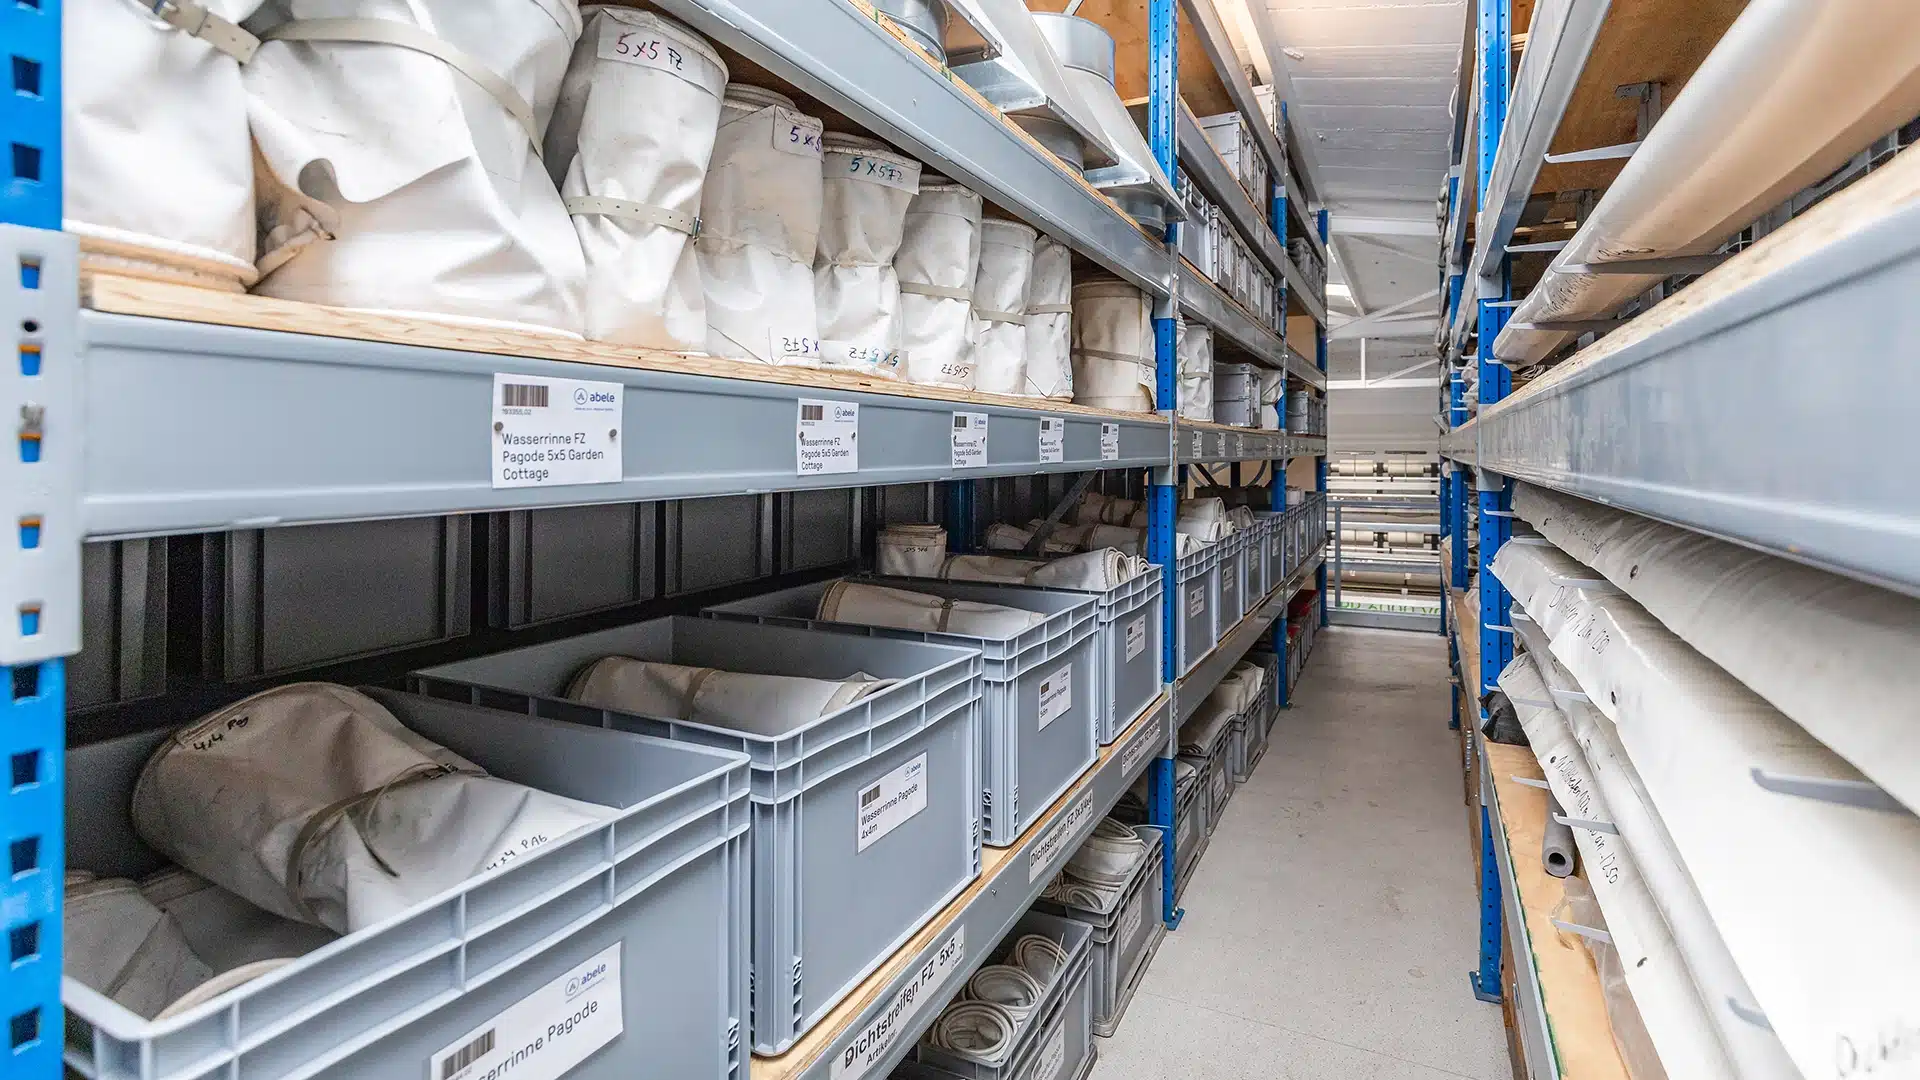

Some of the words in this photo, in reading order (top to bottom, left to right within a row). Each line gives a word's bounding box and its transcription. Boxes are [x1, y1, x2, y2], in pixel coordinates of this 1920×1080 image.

[589, 392, 615, 403] abele
[841, 409, 855, 418] abele
[502, 432, 572, 446] Wasserrinne
[573, 432, 586, 445] FZ
[801, 437, 833, 447] Wasserrinne
[834, 437, 841, 446] FZ
[502, 450, 545, 466] Pagode
[547, 449, 566, 462] 5x5
[568, 449, 604, 460] Garden
[801, 449, 821, 460] Pagode
[821, 448, 831, 458] 5x5
[831, 448, 849, 457] Garden
[801, 461, 823, 471] Cottage
[502, 467, 549, 482] Cottage
[861, 796, 897, 826] Wasserrinne
[898, 783, 918, 803] Pagode
[861, 823, 878, 840] 4x4m
[1030, 823, 1066, 867] Dichtstreifen
[1066, 811, 1075, 829] FZ
[580, 962, 606, 986] abele
[844, 983, 919, 1070] Dichtstreifen
[921, 962, 935, 987] FZ
[939, 937, 955, 966] 5x5
[547, 999, 598, 1043] Pagode
